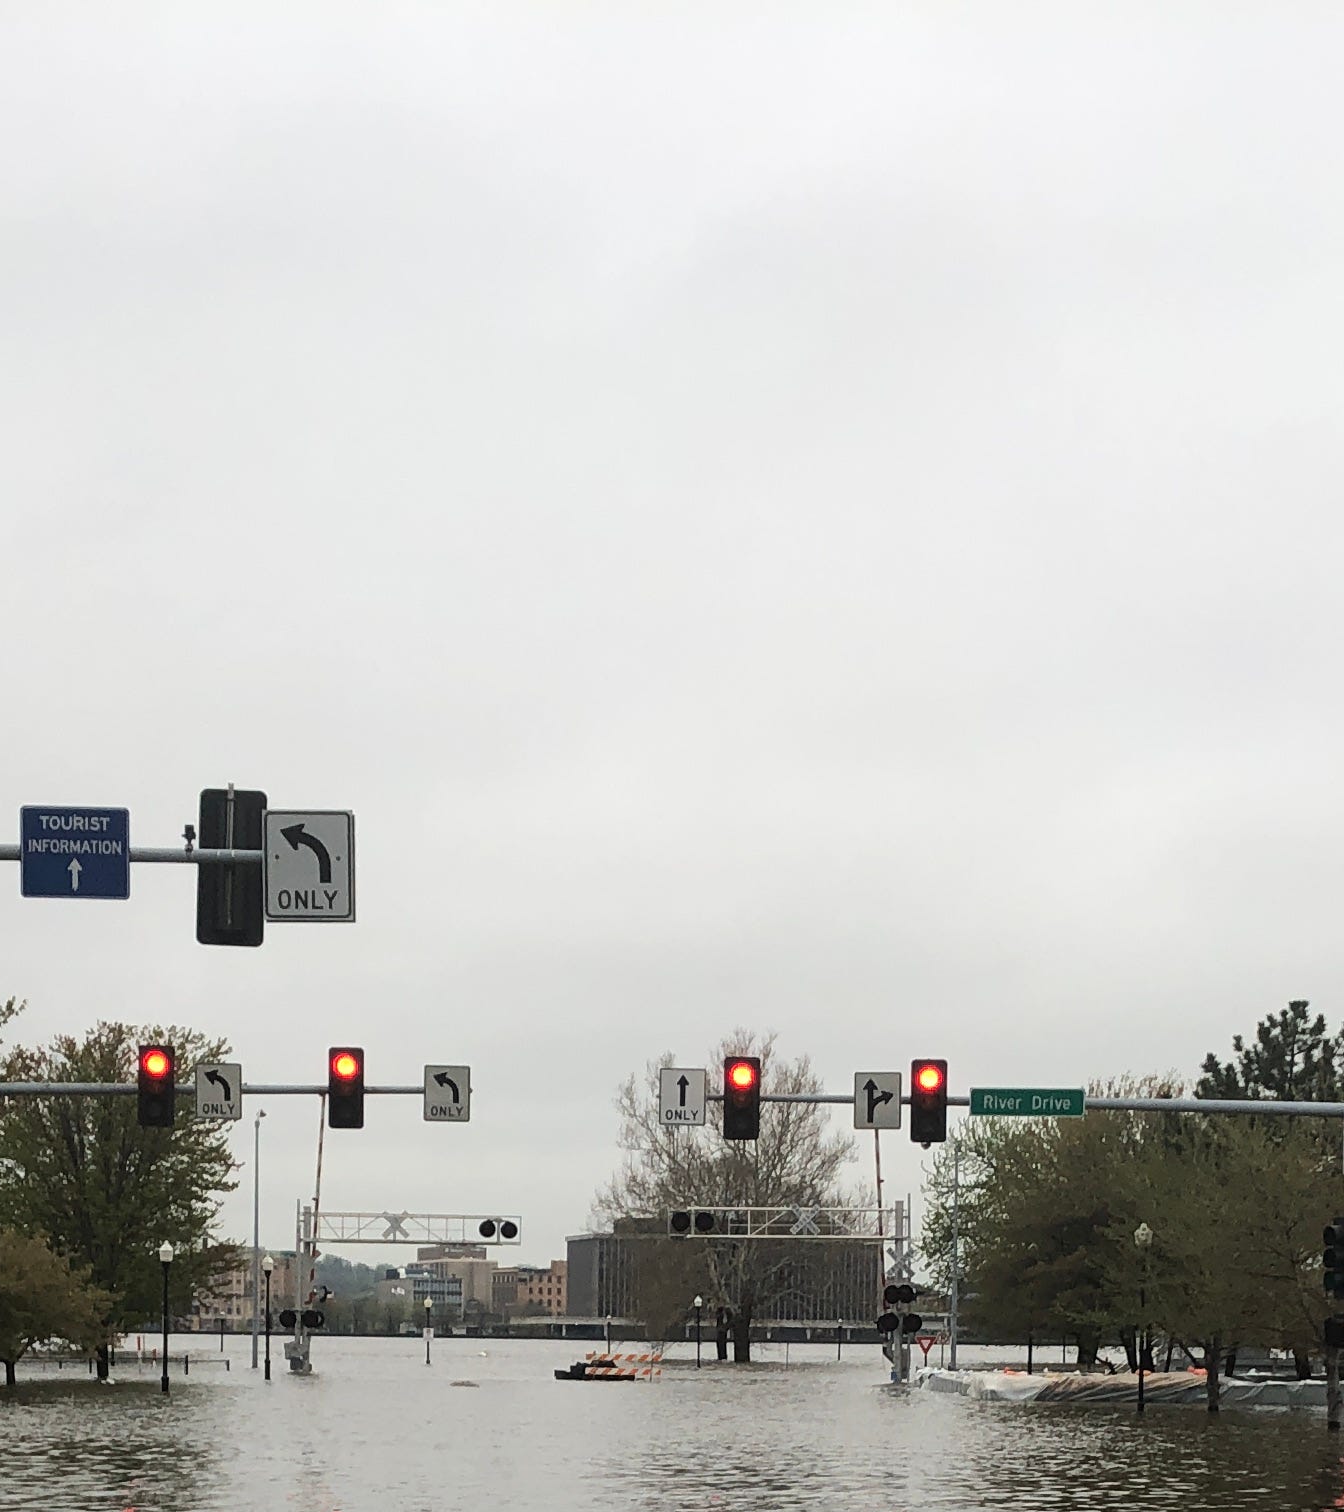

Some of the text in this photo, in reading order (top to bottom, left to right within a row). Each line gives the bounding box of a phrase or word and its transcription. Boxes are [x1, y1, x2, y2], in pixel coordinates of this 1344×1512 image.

[39, 815, 110, 831] TOURIST
[27, 838, 122, 856] INFORMATION
[277, 889, 338, 910] ONLY
[202, 1103, 235, 1115] ONLY
[983, 1094, 1071, 1110] River Drive
[430, 1105, 464, 1117] ONLY
[665, 1109, 698, 1121] ONLY
